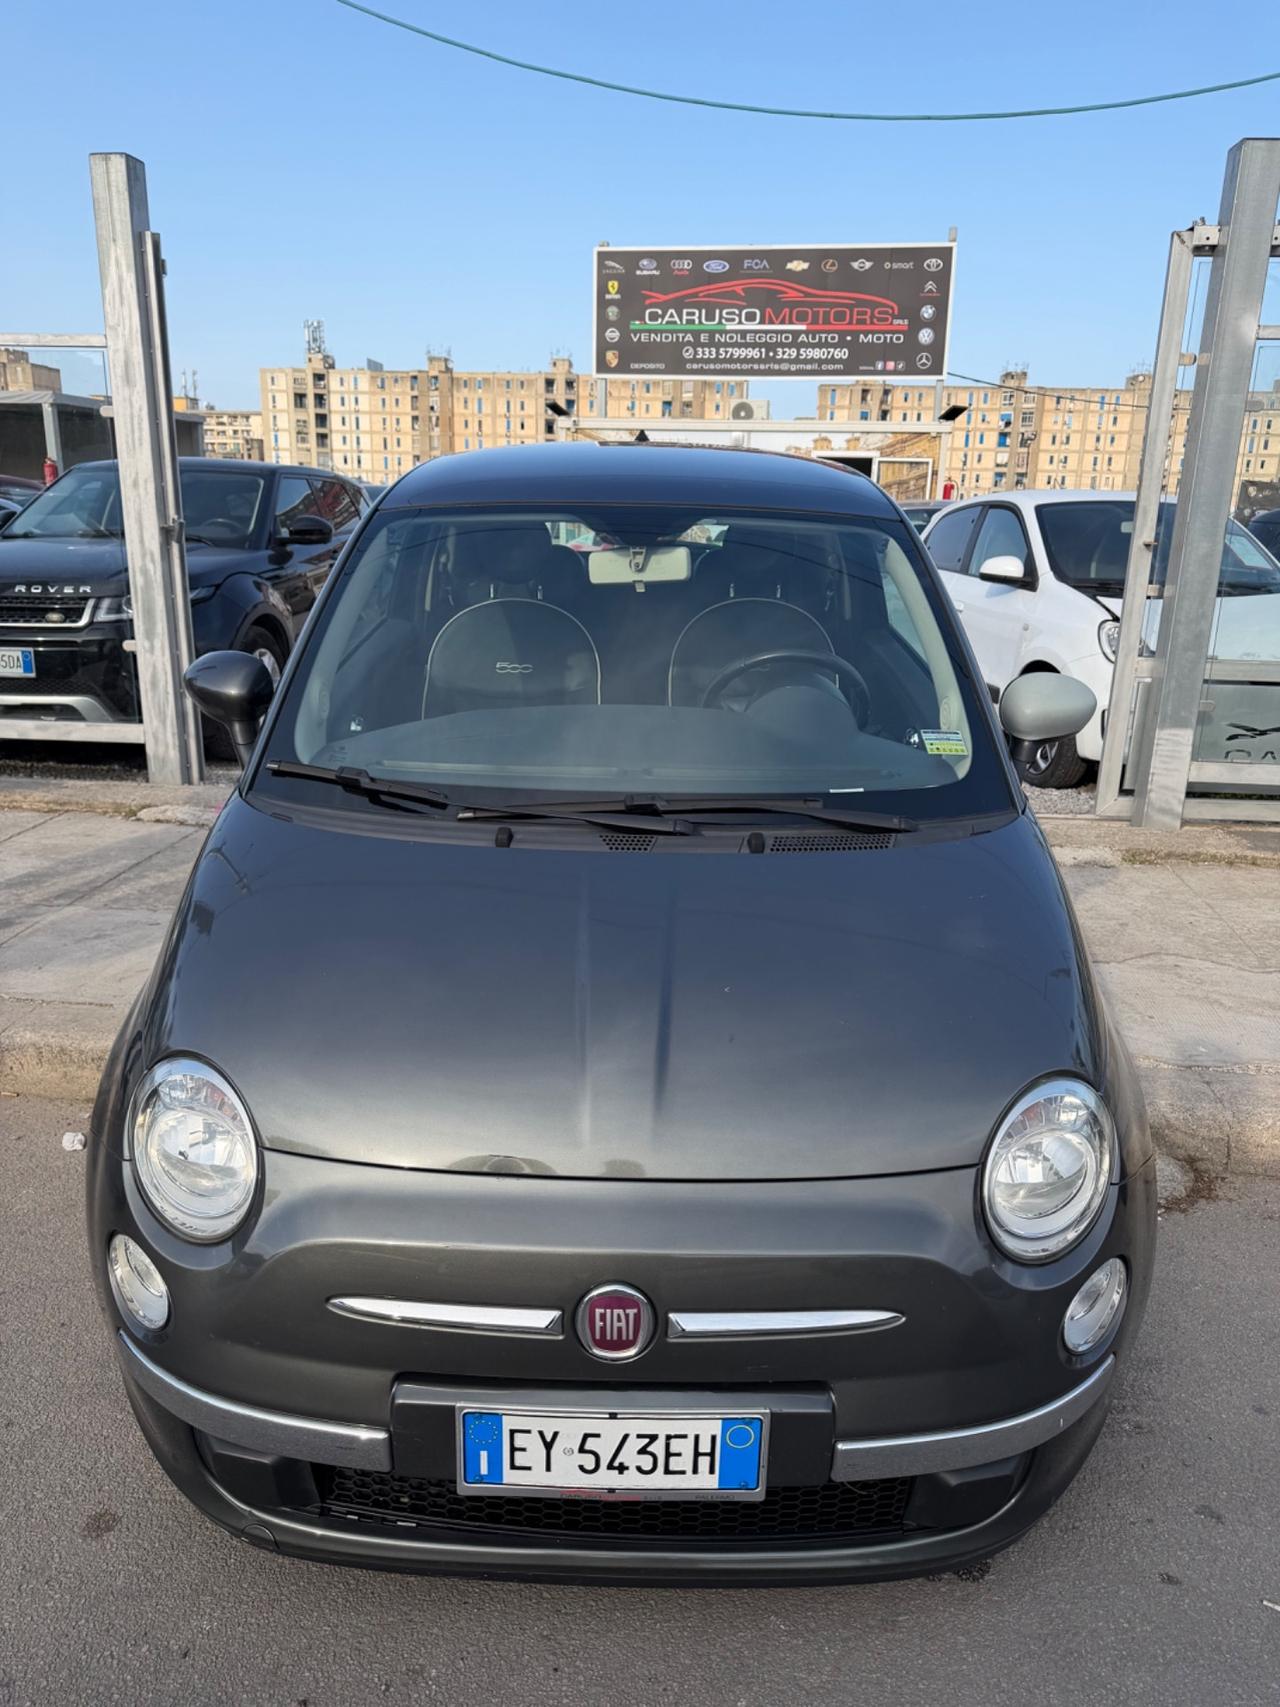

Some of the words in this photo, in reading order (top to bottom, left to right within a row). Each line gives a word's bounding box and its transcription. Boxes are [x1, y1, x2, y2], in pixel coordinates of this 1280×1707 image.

[630, 333, 695, 343] VENDITA
[700, 333, 709, 343] E
[715, 333, 792, 343] NOLEGGIO
[797, 333, 839, 343] AUTO
[859, 333, 905, 344] MOTO
[695, 348, 716, 359] 333
[718, 348, 766, 359] 5799961
[775, 348, 797, 359] 329
[799, 348, 849, 359] 5980760
[14, 584, 92, 593] ROVER
[594, 1308, 638, 1341] FIAT
[508, 1428, 560, 1473] EY
[577, 1432, 717, 1476] 543EH
